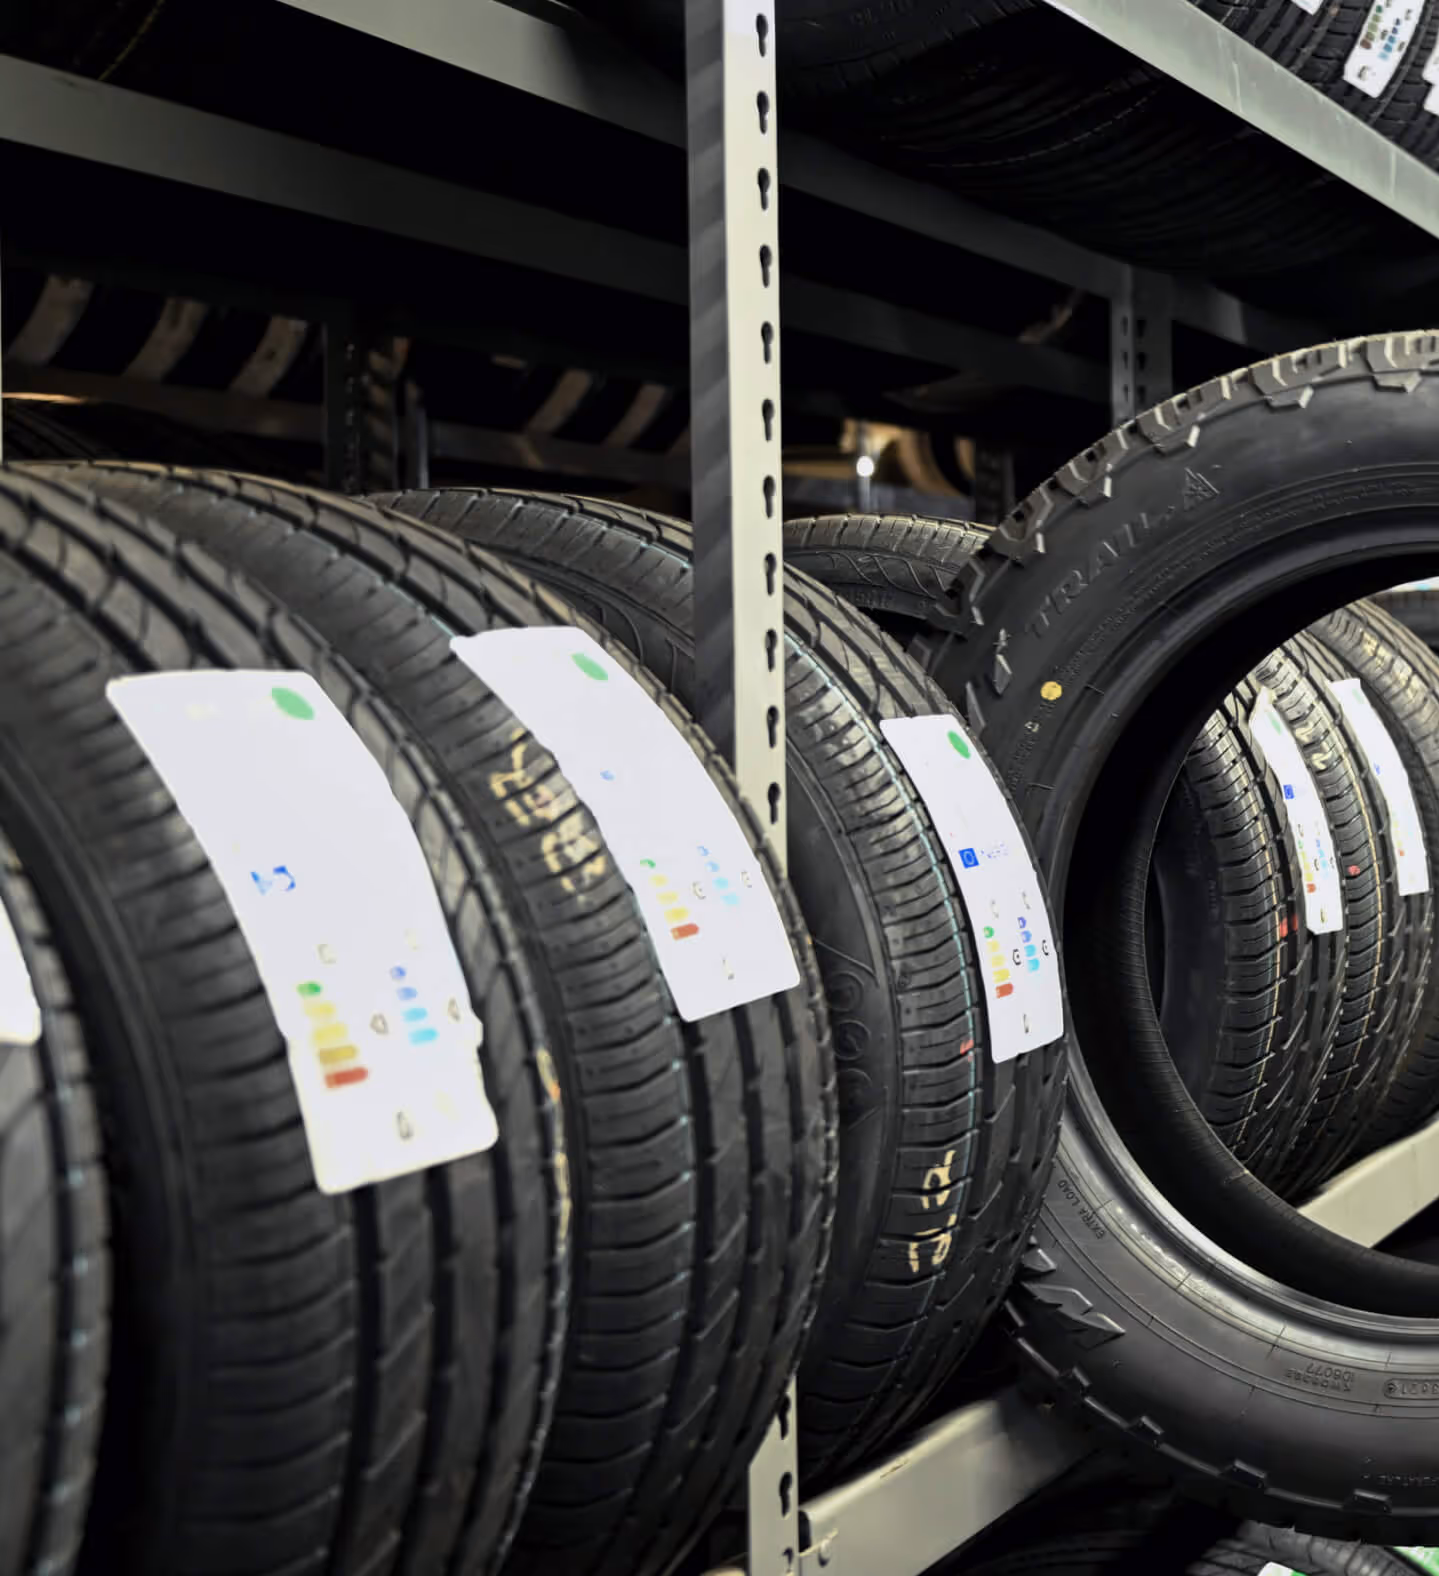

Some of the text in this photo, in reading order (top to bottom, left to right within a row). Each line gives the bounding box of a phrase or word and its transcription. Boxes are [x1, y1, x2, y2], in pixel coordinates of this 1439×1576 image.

[1029, 512, 1157, 637] TRAIL
[1055, 1177, 1106, 1240] EXTRA LOAD
